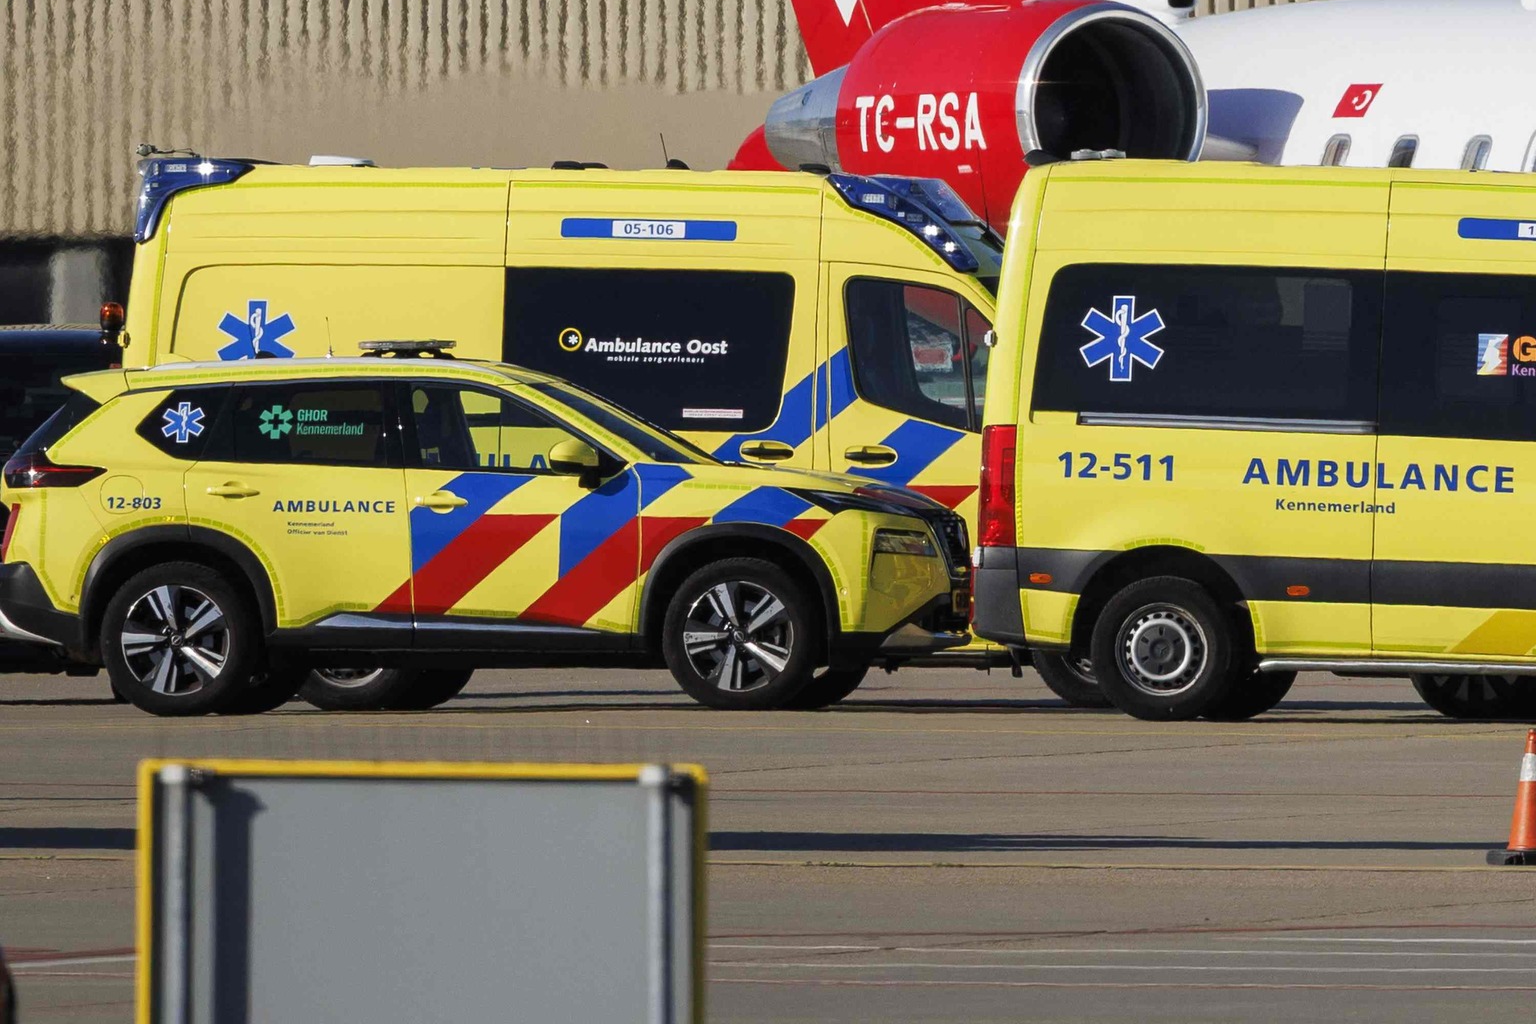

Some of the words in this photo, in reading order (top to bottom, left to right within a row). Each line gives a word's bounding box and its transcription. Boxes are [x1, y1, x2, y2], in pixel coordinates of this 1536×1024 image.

[855, 92, 987, 152] TC-RSA
[624, 223, 674, 236] 05-106
[584, 337, 681, 354] Ambulance
[686, 339, 729, 355] Oost
[606, 355, 640, 363] mobiele
[643, 356, 705, 364] zorgverleners
[296, 409, 329, 422] GHOR
[296, 422, 364, 436] Kennemerland
[1058, 451, 1174, 481] 12-511
[1241, 457, 1515, 494] AMBULANCE
[107, 496, 162, 510] 12-803
[272, 500, 396, 513] AMBULANCE
[1275, 498, 1396, 514] Kennemerland
